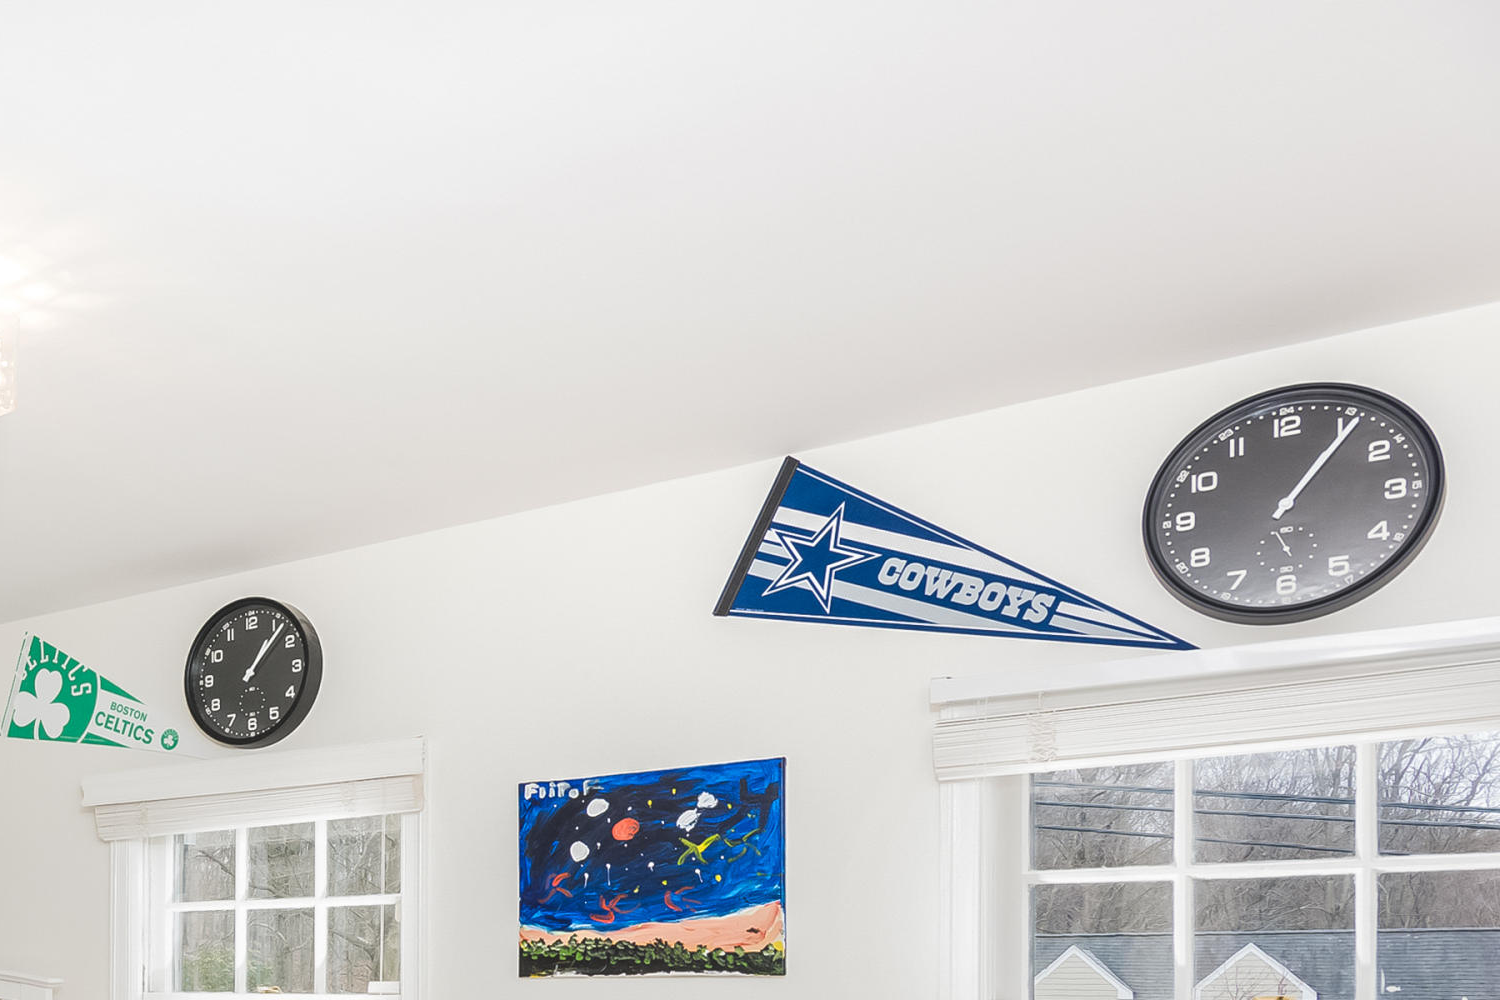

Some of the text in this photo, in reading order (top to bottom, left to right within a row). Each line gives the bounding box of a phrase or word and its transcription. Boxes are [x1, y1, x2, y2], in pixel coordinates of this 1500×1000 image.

[1273, 415, 1302, 438] 12
[1337, 417, 1344, 438] 1
[1229, 437, 1245, 458] 11
[1368, 439, 1391, 462] 2
[1191, 471, 1218, 493] 10
[1384, 478, 1407, 500] 3
[1175, 511, 1196, 532] 9
[1367, 520, 1391, 541] 4
[1190, 547, 1210, 568] 8
[1328, 554, 1350, 576] 5
[1226, 569, 1248, 590] 7
[1276, 574, 1297, 596] 6
[877, 557, 1057, 626] COWBOYS
[245, 616, 258, 630] 12
[272, 619, 276, 632] 1
[227, 628, 235, 641] 11
[285, 634, 296, 648] 2
[211, 649, 224, 663] 10
[291, 659, 302, 673] 3
[204, 675, 214, 688] 9
[285, 685, 296, 698] 4
[109, 701, 148, 722] BOSTON
[211, 698, 221, 711] 8
[269, 706, 279, 720] 5
[94, 711, 155, 745] CELTICS
[227, 713, 236, 727] 7
